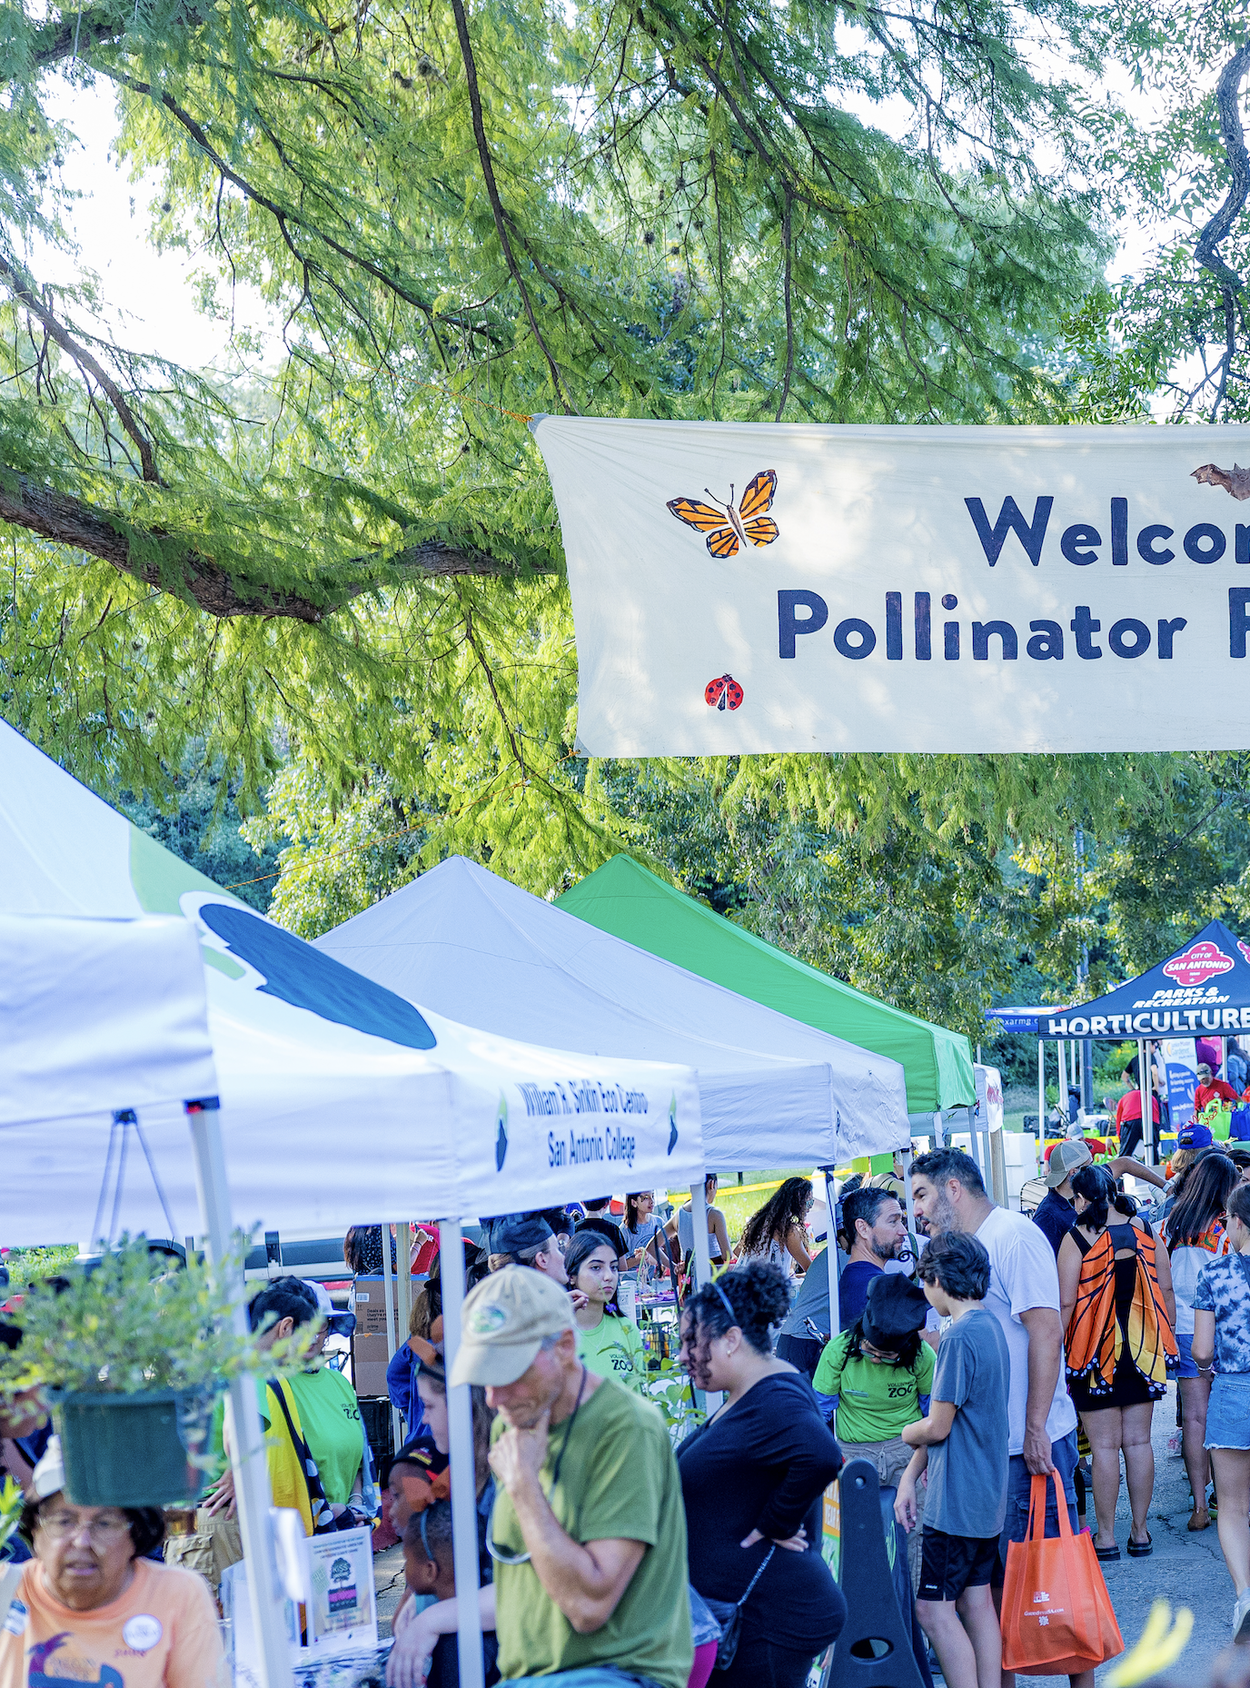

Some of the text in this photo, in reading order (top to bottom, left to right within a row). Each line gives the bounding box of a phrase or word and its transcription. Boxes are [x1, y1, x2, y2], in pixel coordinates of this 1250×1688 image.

[777, 588, 1188, 661] Pollinator
[1191, 952, 1204, 960] CITY
[1166, 960, 1231, 972] SAN ANTONIO
[1152, 986, 1220, 1000] PARKS &
[1132, 995, 1230, 1009] RECREATION
[514, 1082, 561, 1117] William
[567, 1079, 600, 1114] Sinkin
[596, 1081, 619, 1113] Eco
[615, 1082, 649, 1115] Centro
[547, 1126, 636, 1168] San Antonio College
